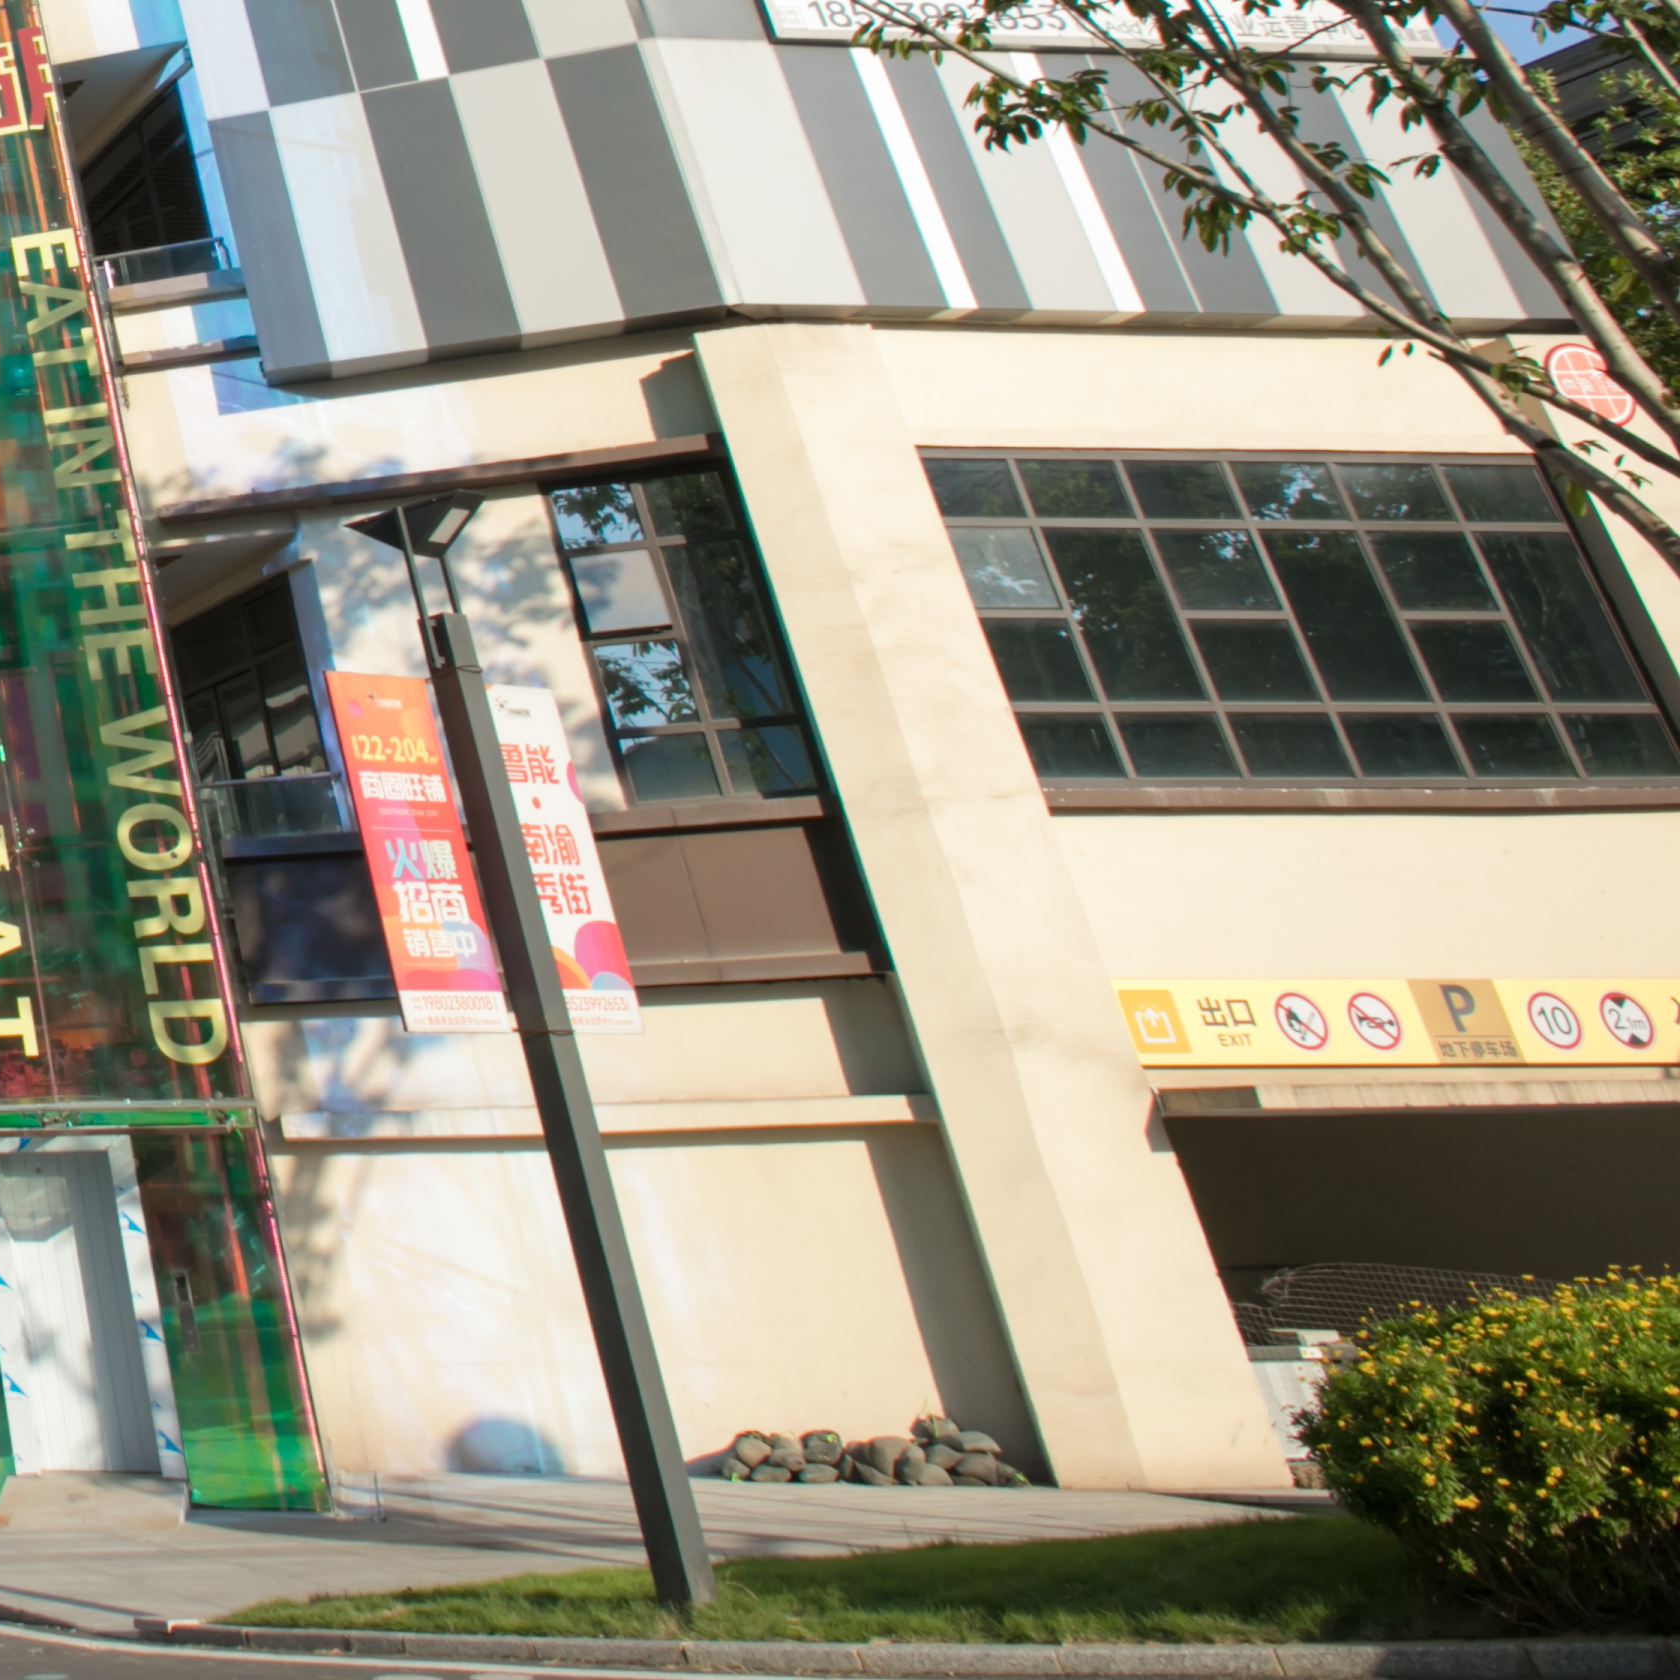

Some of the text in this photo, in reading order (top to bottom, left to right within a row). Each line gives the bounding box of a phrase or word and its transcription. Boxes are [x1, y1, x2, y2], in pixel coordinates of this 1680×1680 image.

[11, 228, 231, 1068] EAT IN THE WORLD
[358, 771, 447, 803] 商圈旺铺
[383, 838, 459, 880] 火爆
[392, 881, 470, 924] 招商
[403, 928, 478, 958] 销售中
[1196, 996, 1258, 1027] 出口
[1438, 984, 1476, 1032] P
[1536, 1006, 1572, 1036] 10
[1608, 1008, 1648, 1030] 2.1m
[1216, 1033, 1253, 1047] EXIT
[1437, 1040, 1518, 1058] 地下停车场
